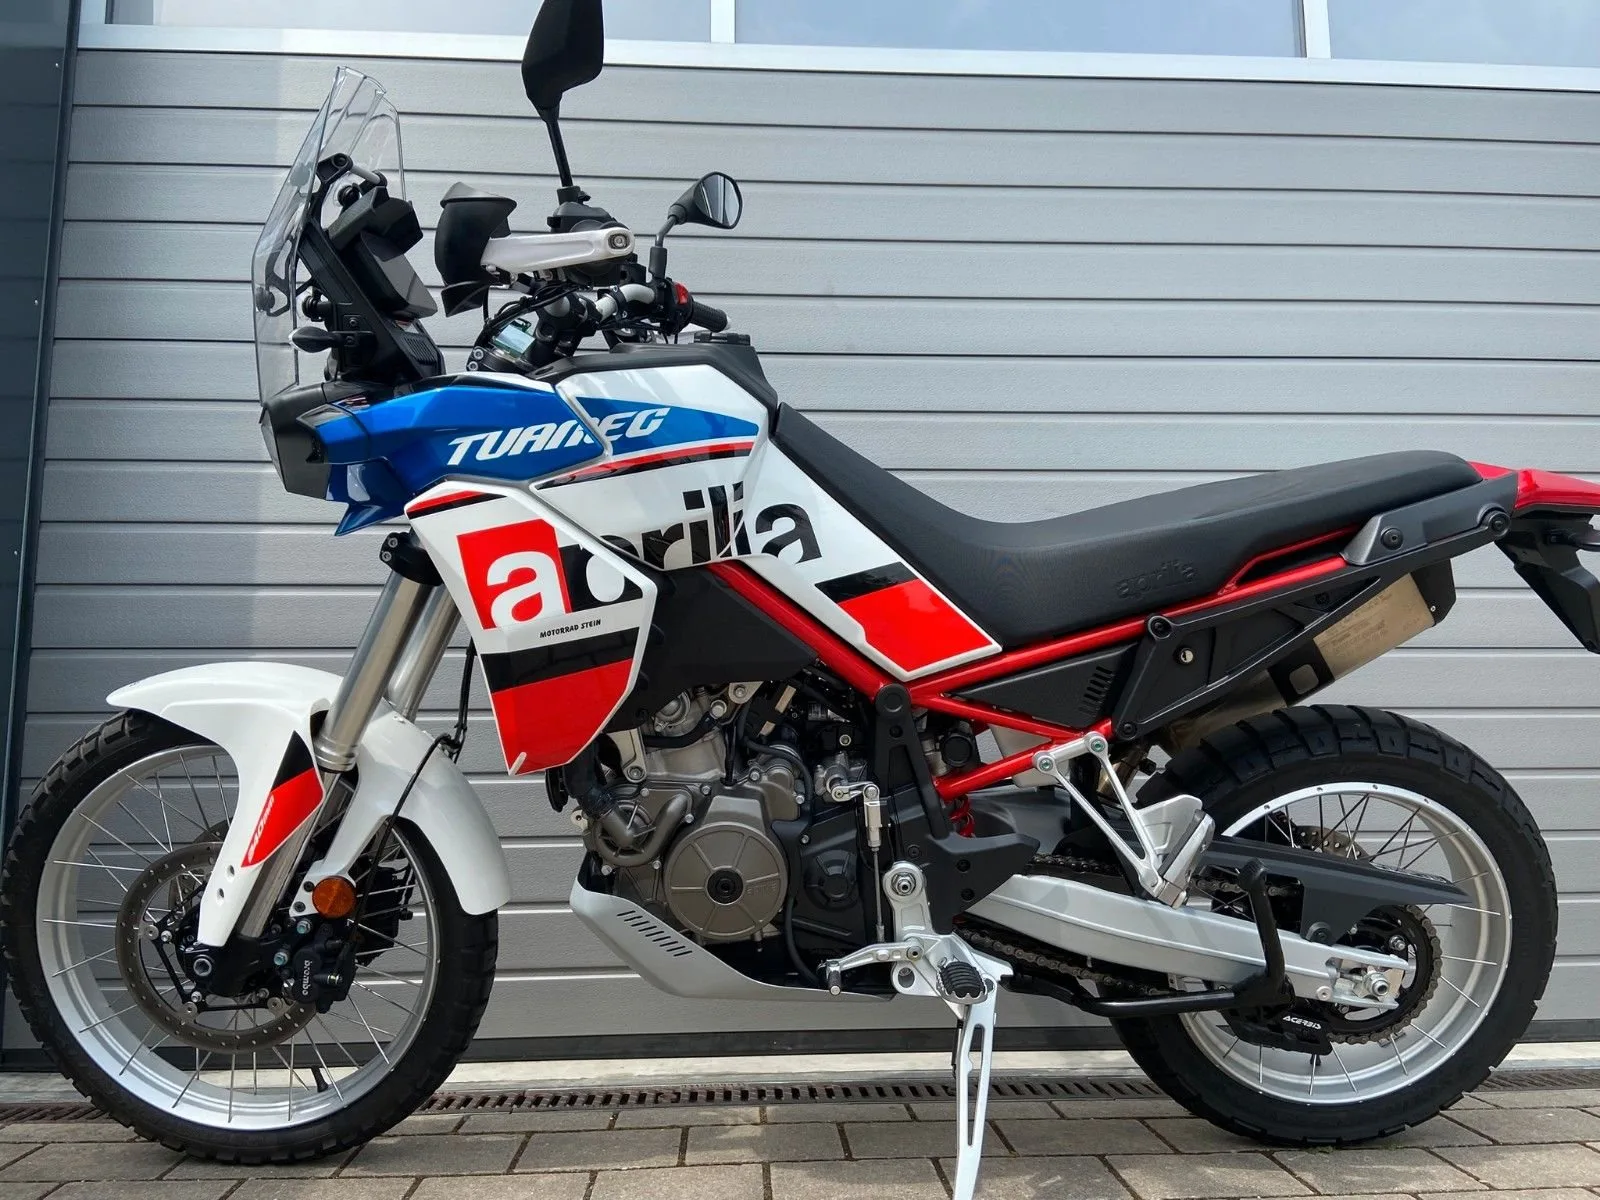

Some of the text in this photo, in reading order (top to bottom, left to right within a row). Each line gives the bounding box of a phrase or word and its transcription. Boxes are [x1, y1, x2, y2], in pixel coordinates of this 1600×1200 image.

[540, 619, 601, 638] MOTORRAD STEIN
[302, 960, 312, 996] brembo
[1282, 1015, 1322, 1030] ACERBIS
